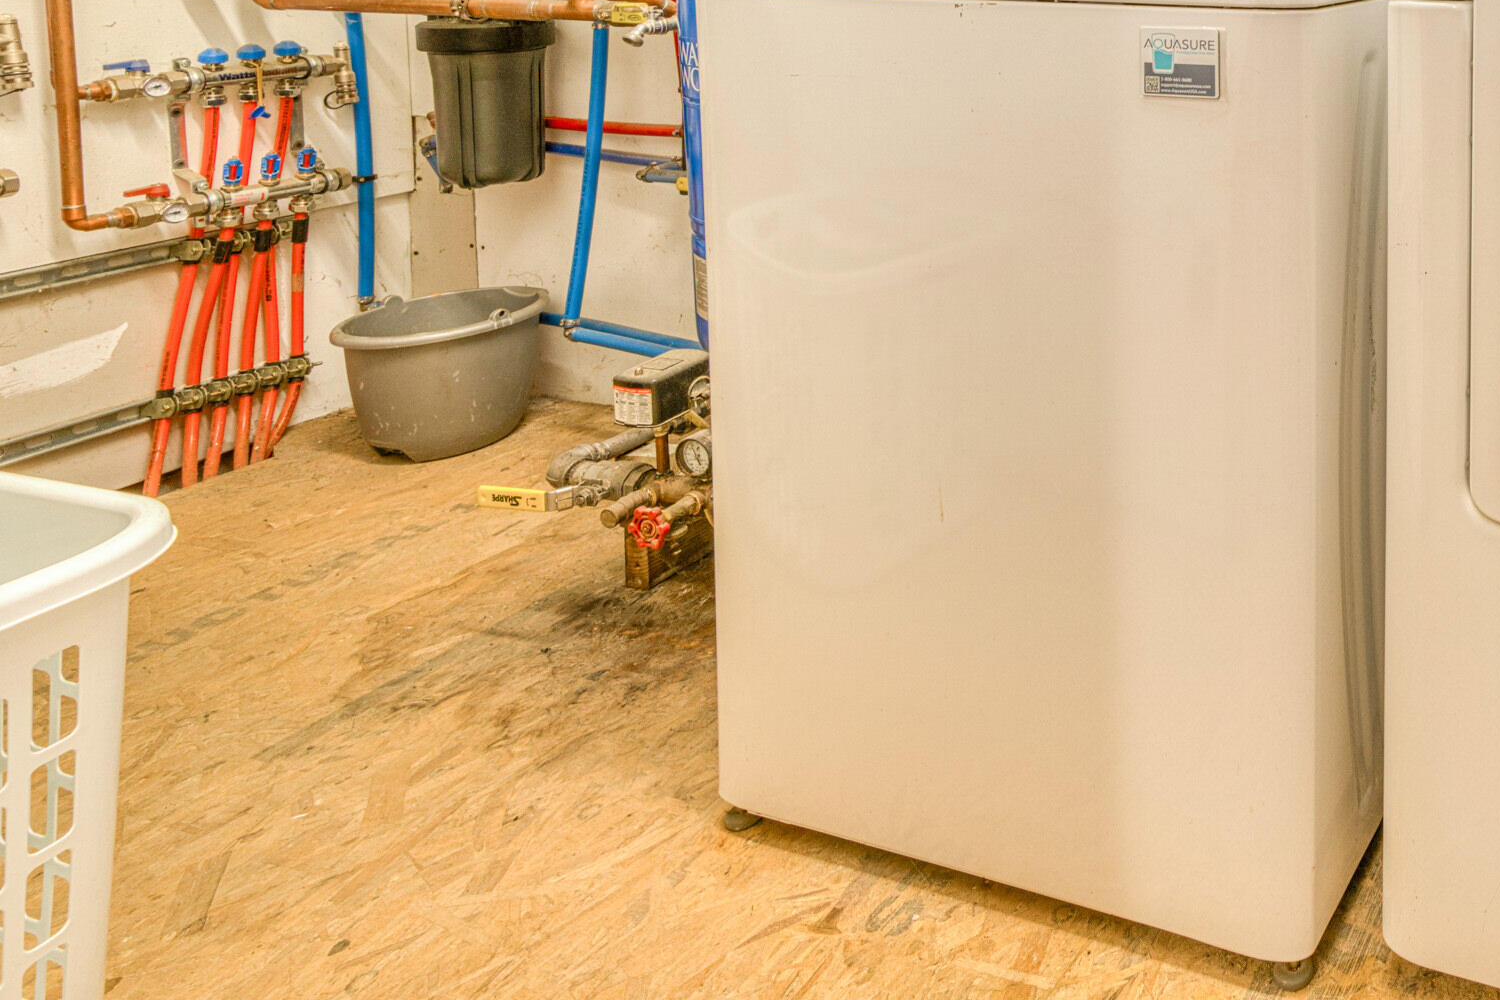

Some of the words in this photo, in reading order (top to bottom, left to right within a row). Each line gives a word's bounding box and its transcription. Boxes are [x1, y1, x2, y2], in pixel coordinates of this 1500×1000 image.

[1144, 38, 1216, 51] AQUASURE
[219, 72, 256, 81] Watts
[492, 494, 522, 506] SHARPE
